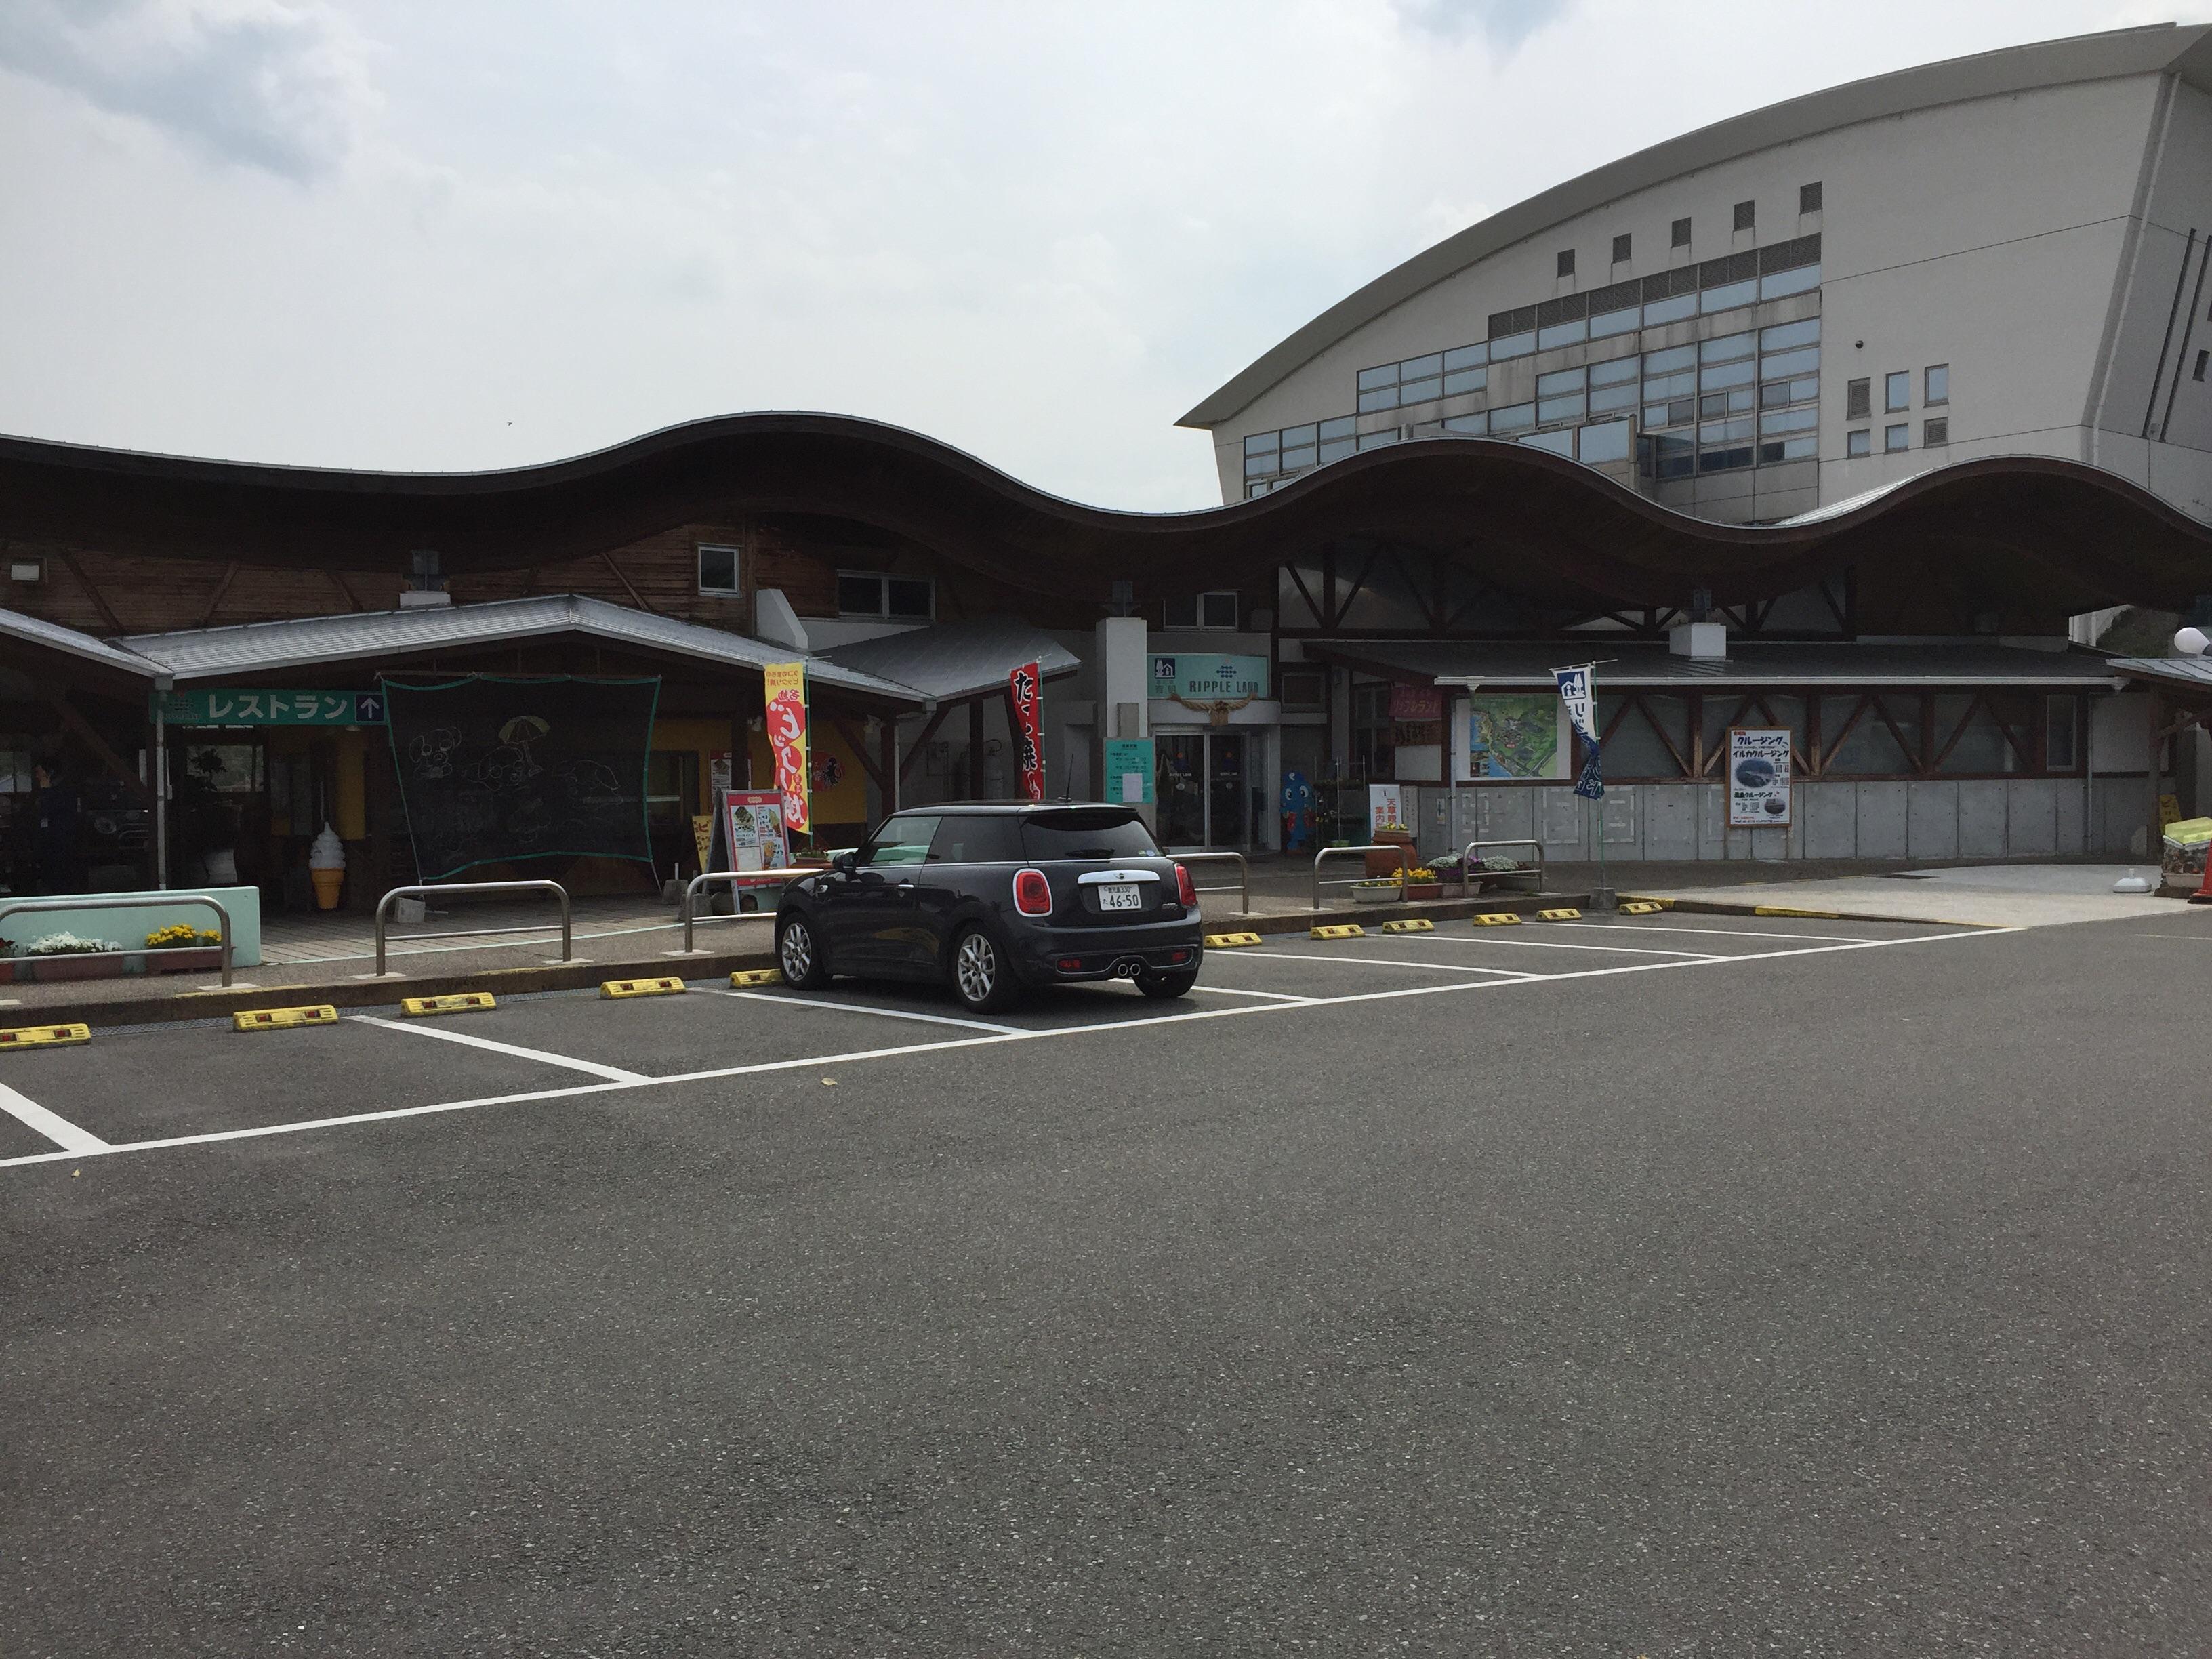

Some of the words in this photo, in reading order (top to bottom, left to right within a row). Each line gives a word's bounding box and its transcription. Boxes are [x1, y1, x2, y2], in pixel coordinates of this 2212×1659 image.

[1189, 680, 1231, 693] RIPPLE
[209, 693, 348, 720] レストラン
[1737, 736, 1784, 745] クルージング
[1733, 750, 1790, 758] イルカクルージング
[1109, 894, 1139, 907] 46-50
